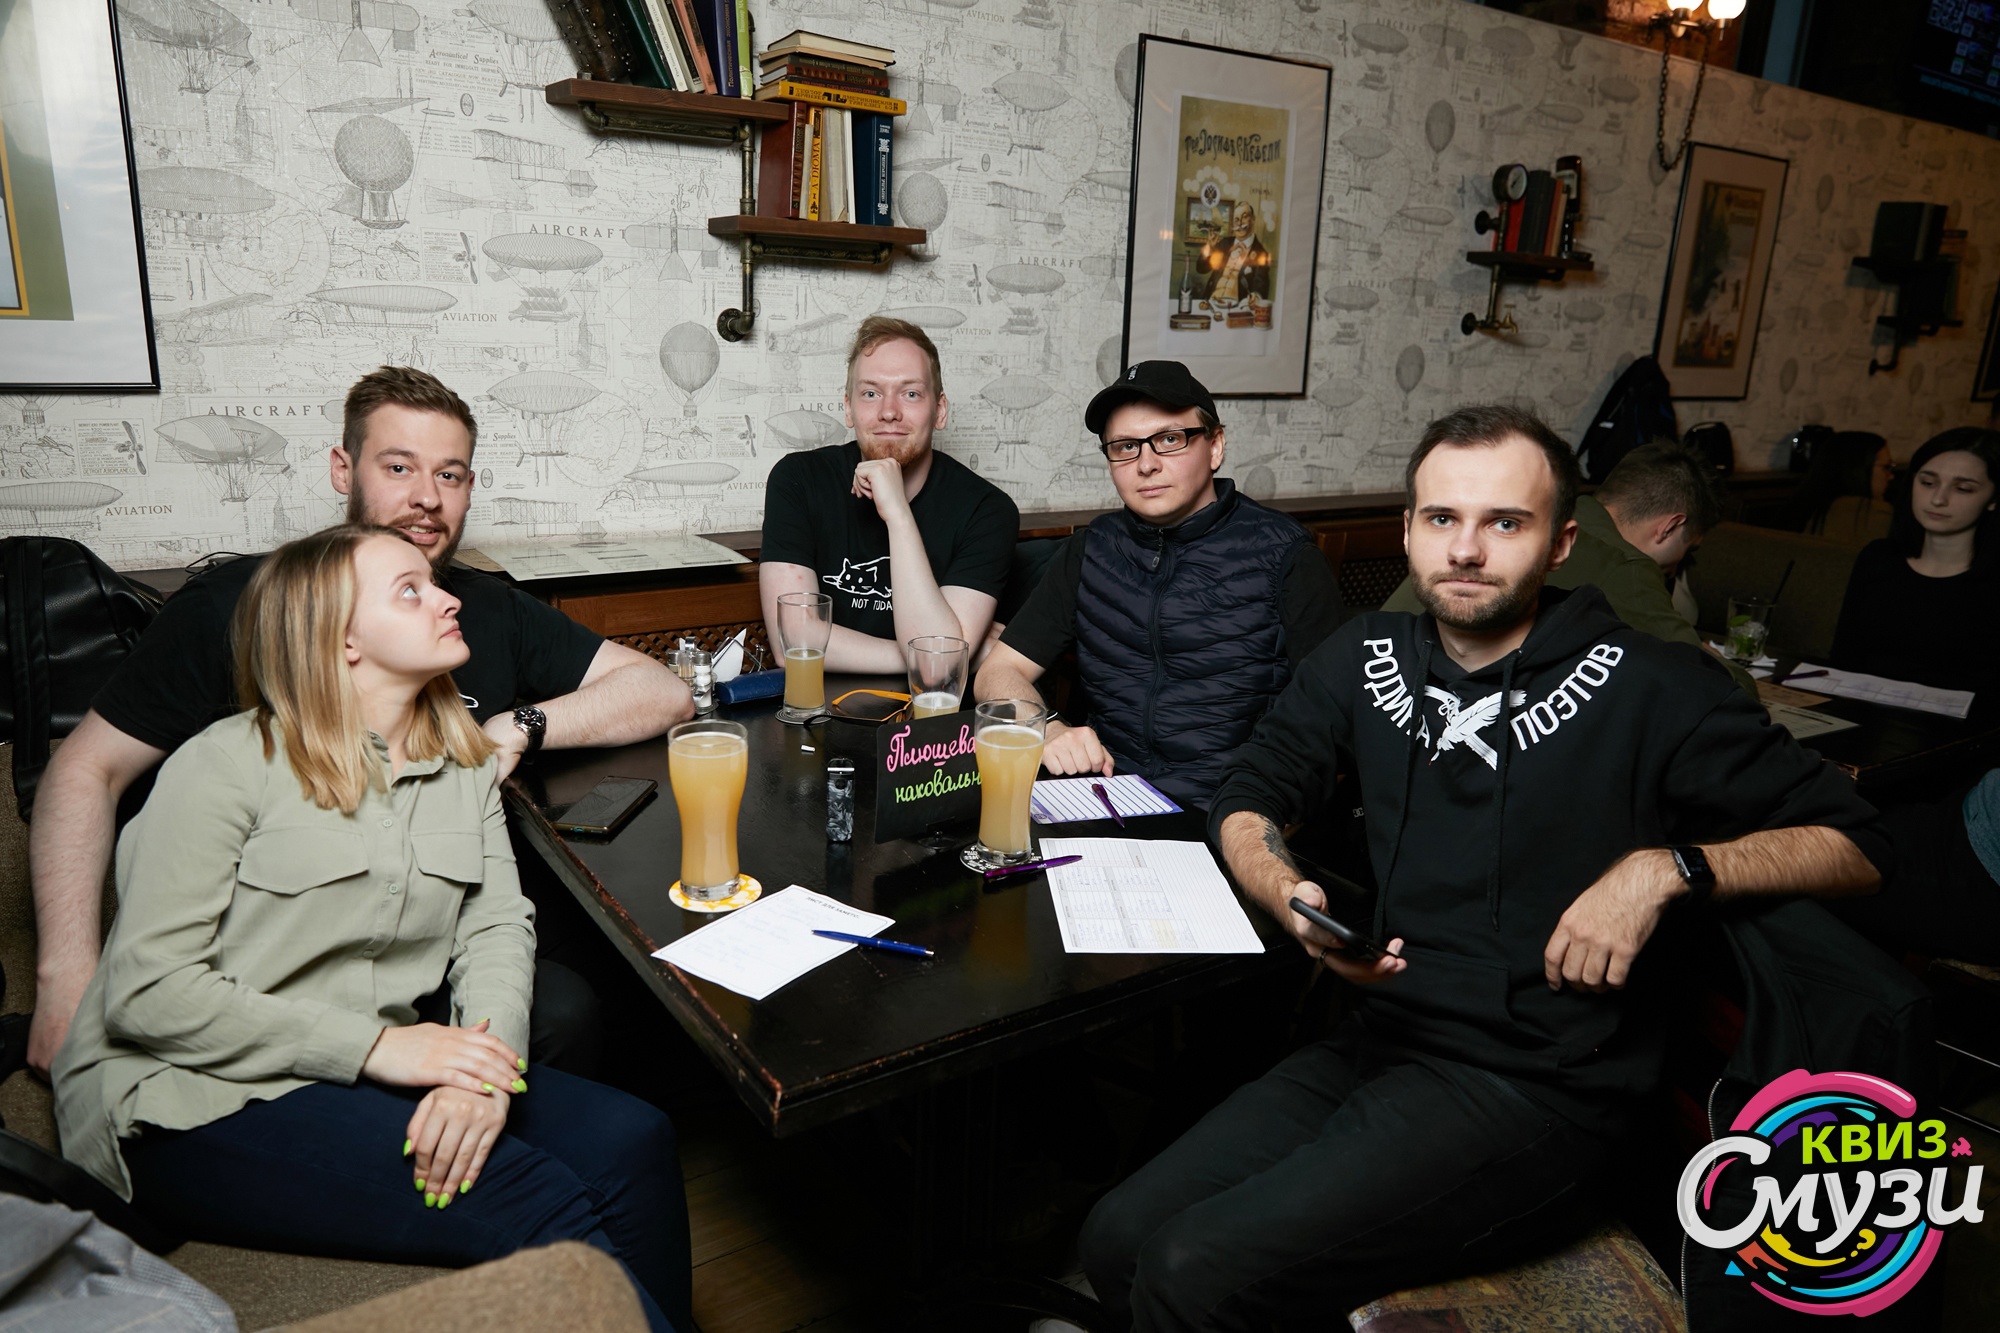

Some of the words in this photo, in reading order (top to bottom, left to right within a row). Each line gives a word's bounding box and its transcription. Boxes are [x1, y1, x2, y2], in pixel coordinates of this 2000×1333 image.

[966, 9, 1005, 23] AVIATION
[429, 49, 469, 61] Aeronautical
[473, 54, 499, 66] Supplies
[529, 223, 626, 239] AIRCRAFT
[1018, 256, 1082, 269] AIRCRAFT
[442, 312, 497, 323] AVIATION
[955, 327, 992, 336] AVIATION
[207, 405, 326, 417] AIRCRAFT
[799, 402, 844, 412] AIRCR
[105, 505, 173, 517] AVIATION
[851, 598, 869, 609] NOT
[873, 600, 893, 611] TODA
[1510, 643, 1624, 751] ПОЭТОВ
[886, 724, 977, 773] Плюшева
[895, 768, 982, 804] наковальн
